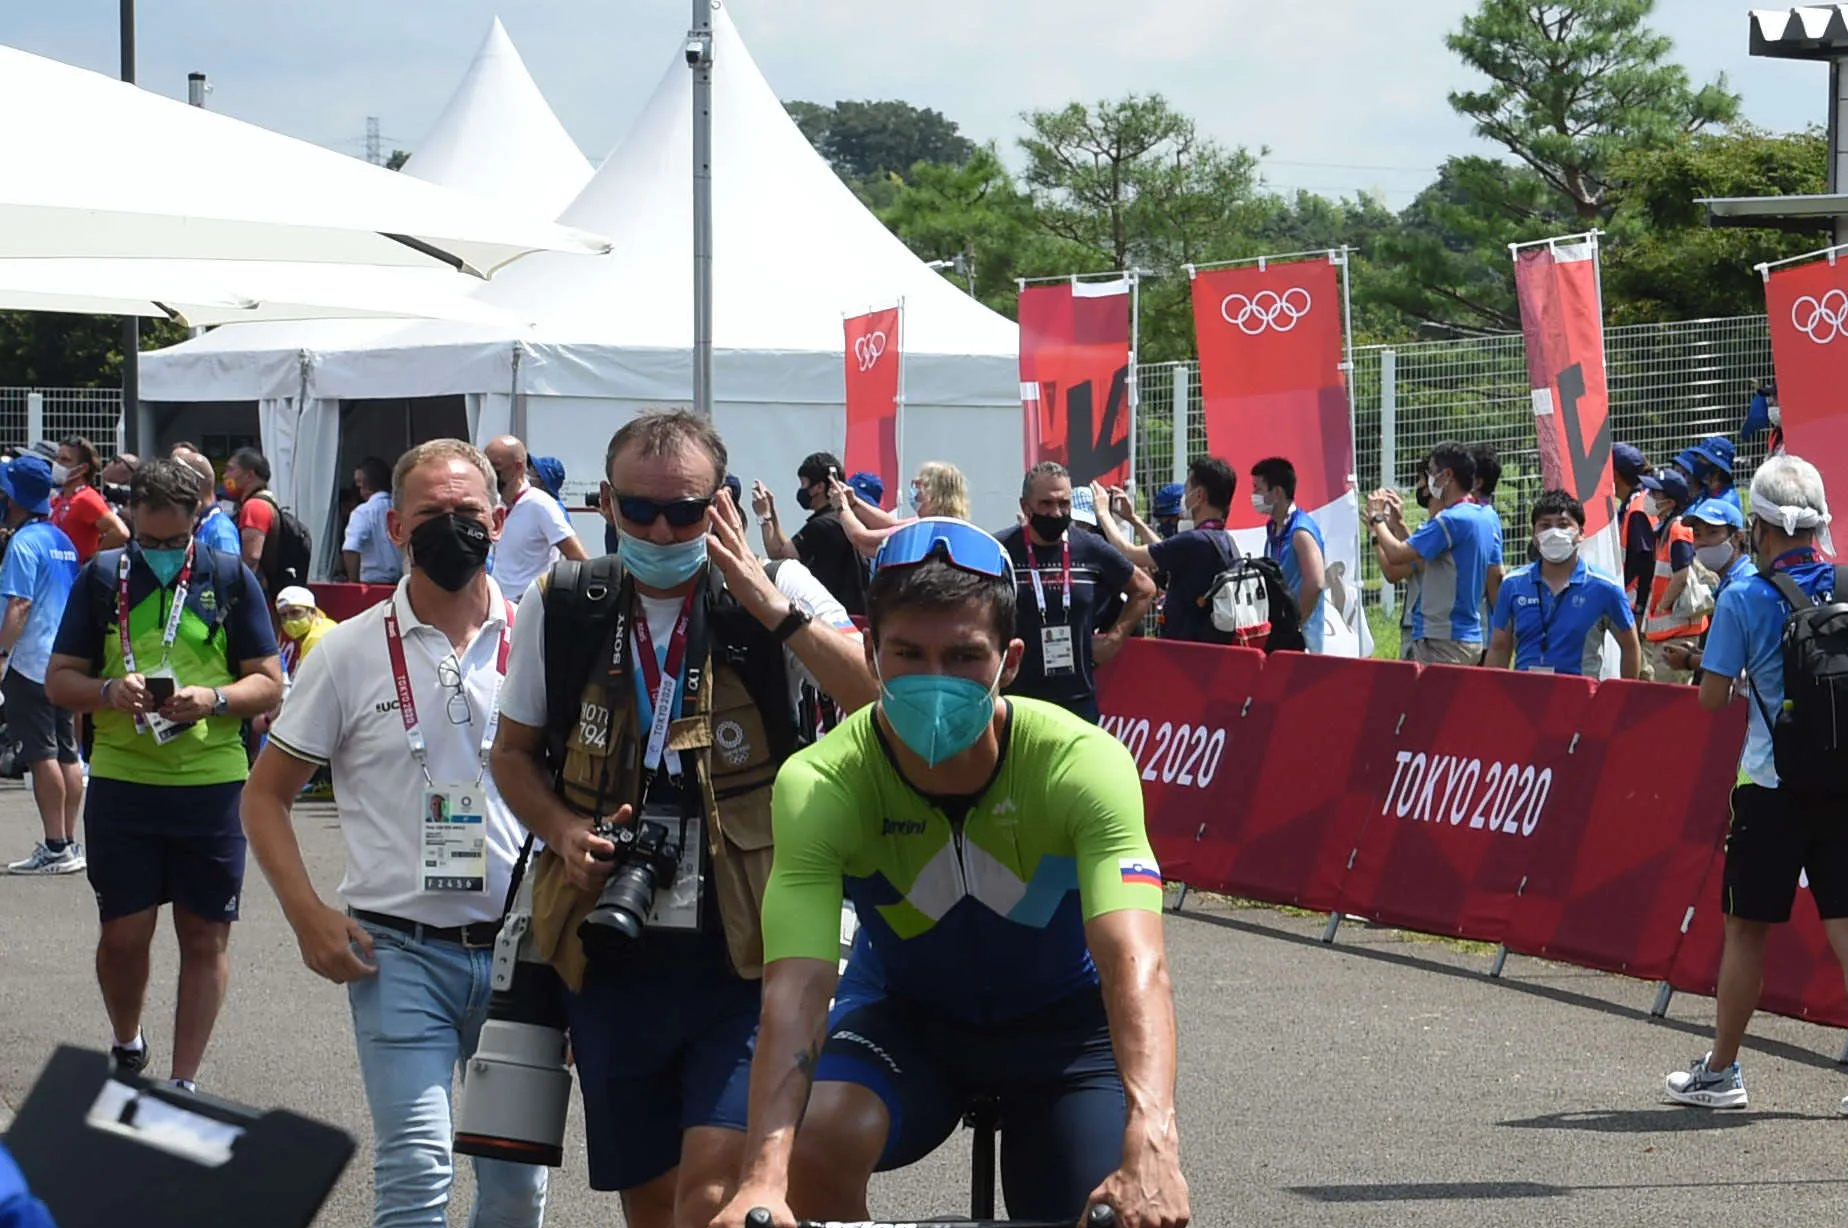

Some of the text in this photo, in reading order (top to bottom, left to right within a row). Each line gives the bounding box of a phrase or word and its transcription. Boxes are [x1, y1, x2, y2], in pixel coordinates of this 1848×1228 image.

[612, 614, 625, 665] SONY
[381, 700, 400, 712] UC
[653, 703, 669, 735] TOKYO
[662, 680, 673, 702] 2020
[1141, 721, 1226, 788] 2020
[1382, 750, 1552, 837] TOKYO 2020
